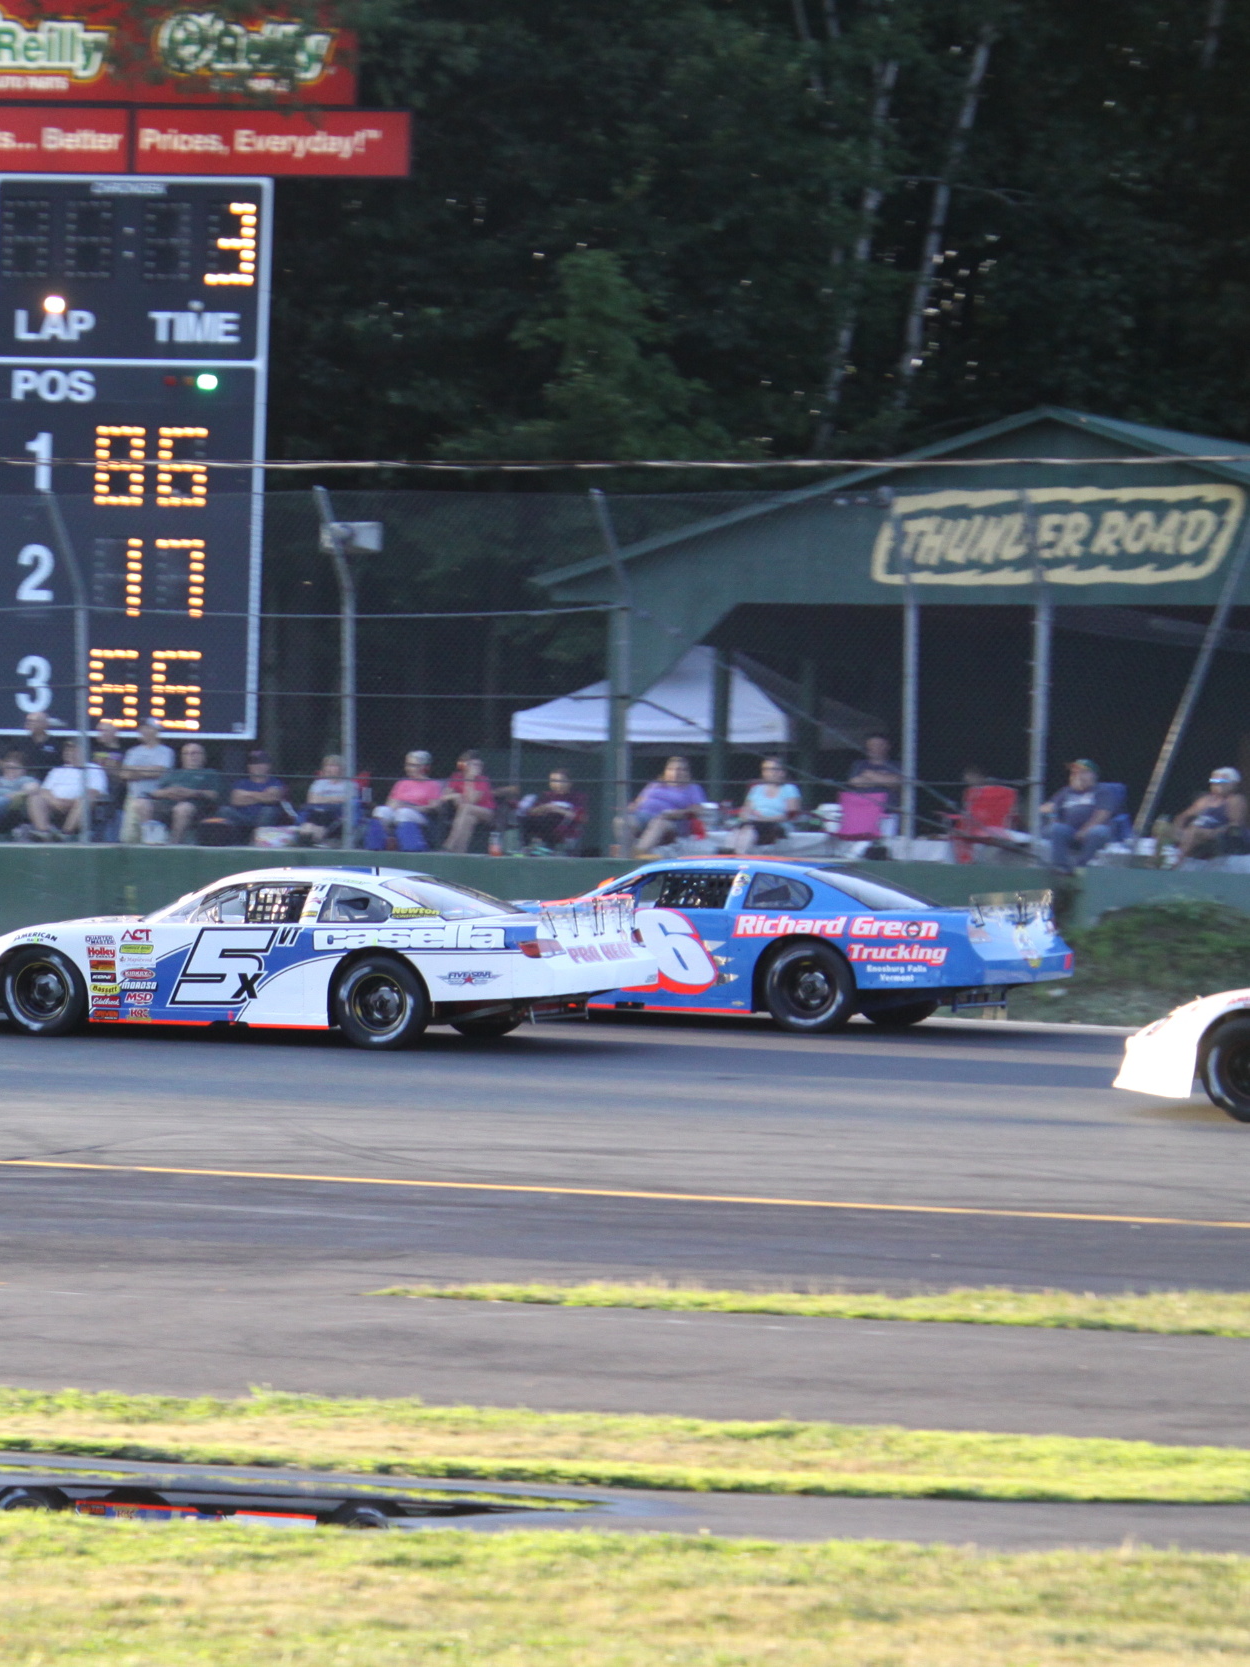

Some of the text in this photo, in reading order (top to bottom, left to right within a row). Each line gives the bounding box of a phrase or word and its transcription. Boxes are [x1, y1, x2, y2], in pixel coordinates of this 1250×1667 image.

[41, 127, 124, 150] Better
[204, 203, 256, 286] 3
[14, 310, 96, 341] LAP
[148, 311, 241, 343] TIME
[11, 370, 96, 401] POS
[25, 432, 53, 492] 1
[93, 425, 209, 507] 86
[1091, 509, 1218, 556] ROAD
[16, 544, 55, 601] 2
[125, 537, 206, 617] 17
[15, 655, 52, 713] 3
[88, 648, 202, 730] 66
[13, 931, 58, 942] AMERICAN
[121, 928, 152, 942] ACT
[278, 926, 303, 945] VT
[734, 915, 847, 936] Richard
[87, 946, 116, 958] Holley
[847, 944, 948, 966] Trucking
[126, 992, 153, 1002] MSD
